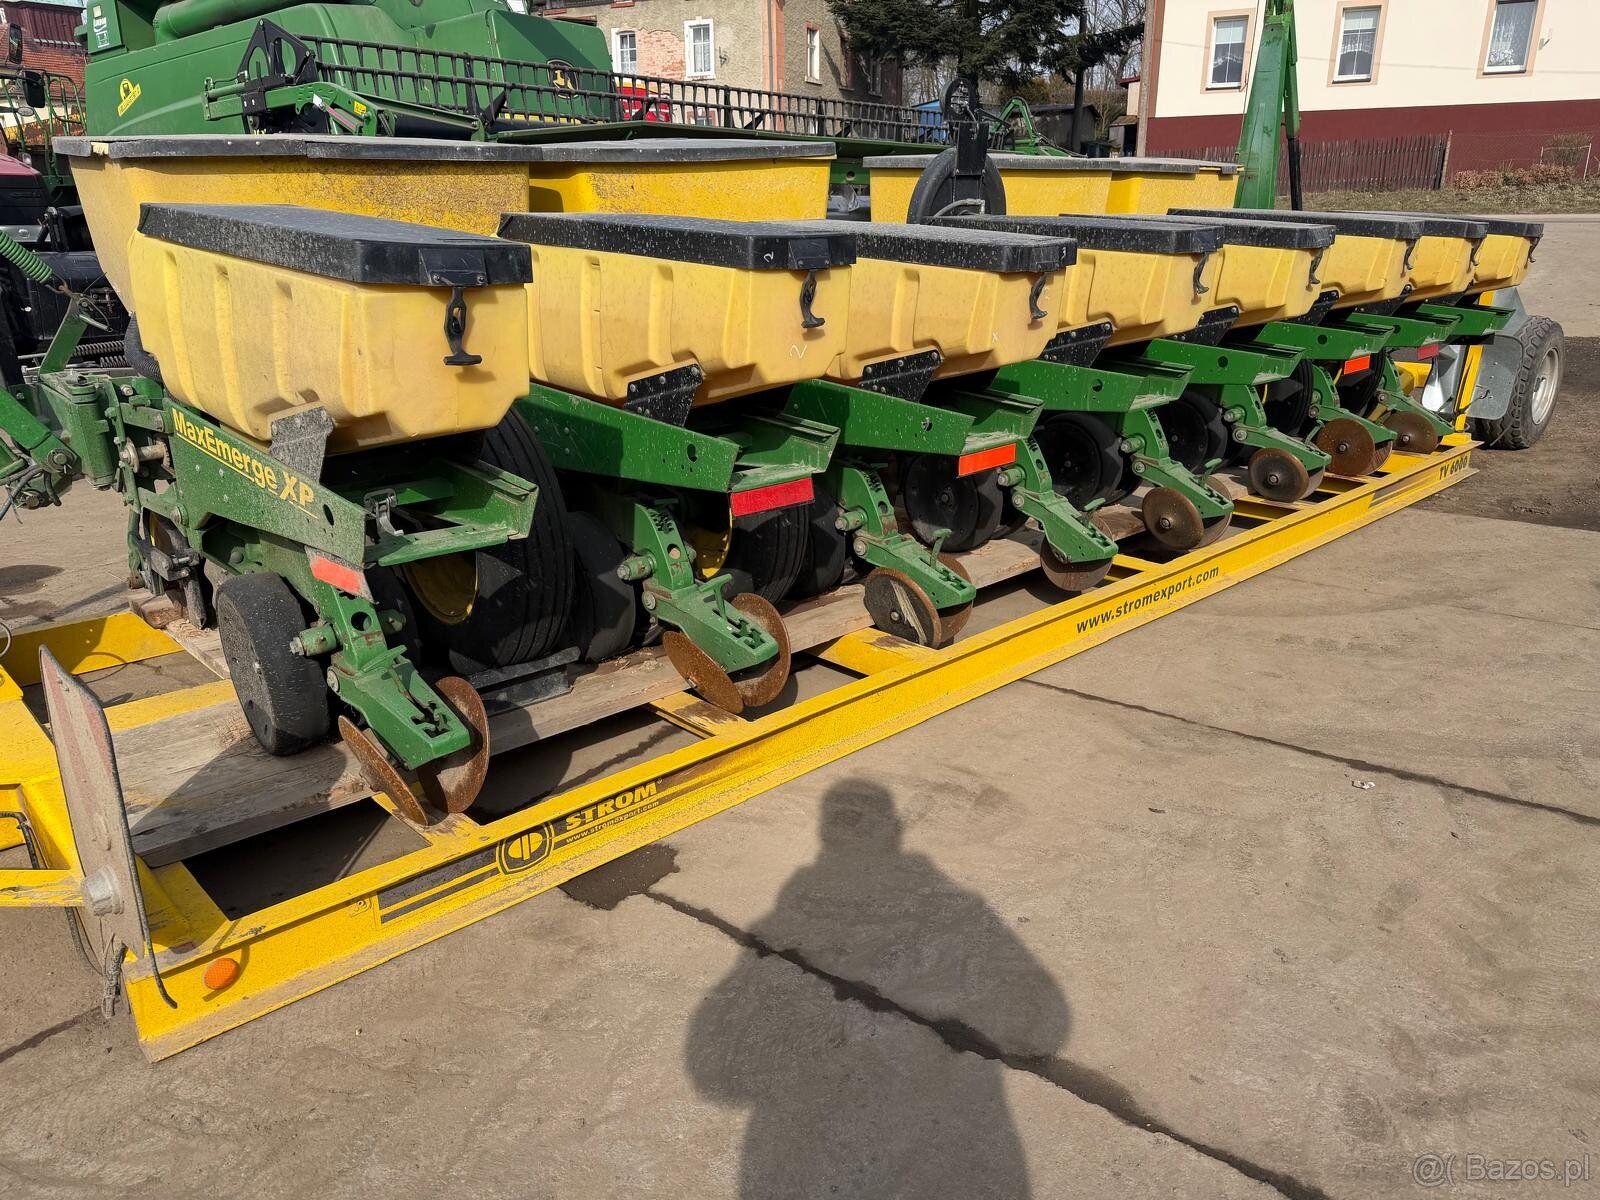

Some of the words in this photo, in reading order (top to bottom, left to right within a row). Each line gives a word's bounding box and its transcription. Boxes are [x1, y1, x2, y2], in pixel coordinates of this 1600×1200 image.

[171, 407, 278, 489] MaxEmerge
[279, 471, 315, 508] XP
[1439, 464, 1449, 480] TV
[1450, 456, 1468, 475] 6000
[1076, 565, 1219, 634] www.stromexport.com
[565, 781, 658, 831] STROM
[565, 800, 660, 844] www.stromexport.com
